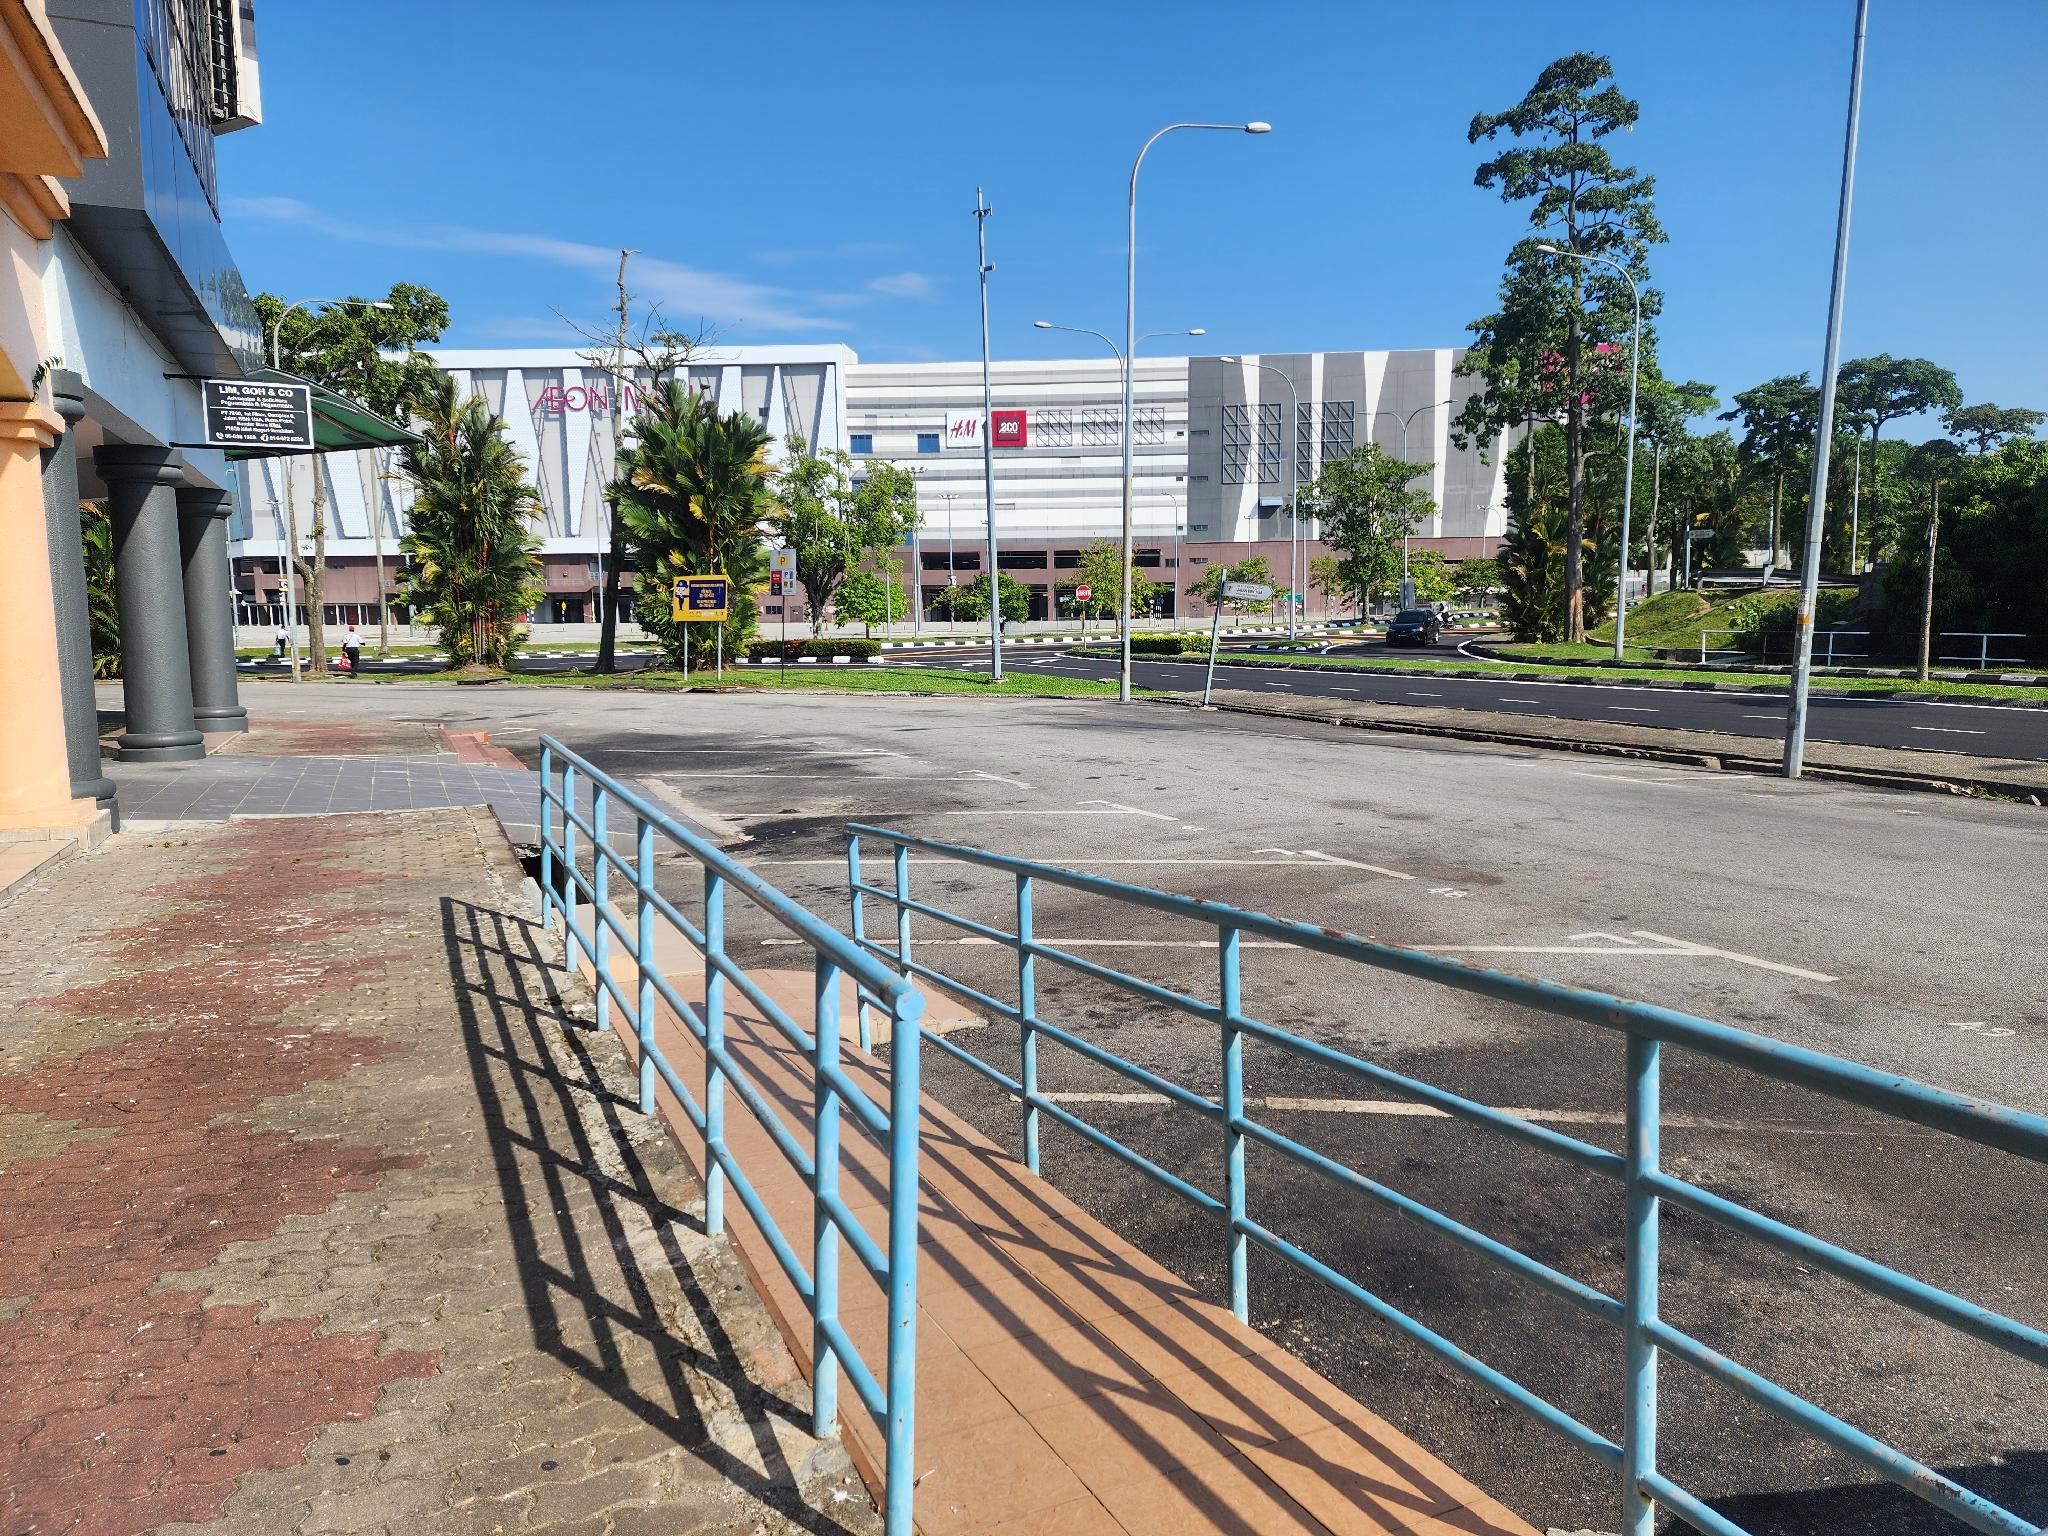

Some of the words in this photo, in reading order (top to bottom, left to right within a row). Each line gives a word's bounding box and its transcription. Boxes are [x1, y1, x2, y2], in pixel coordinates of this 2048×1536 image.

[218, 385, 240, 395] LIM,
[241, 387, 266, 396] GOH
[267, 388, 276, 397] &
[277, 388, 294, 397] CO
[950, 419, 976, 438] H&M
